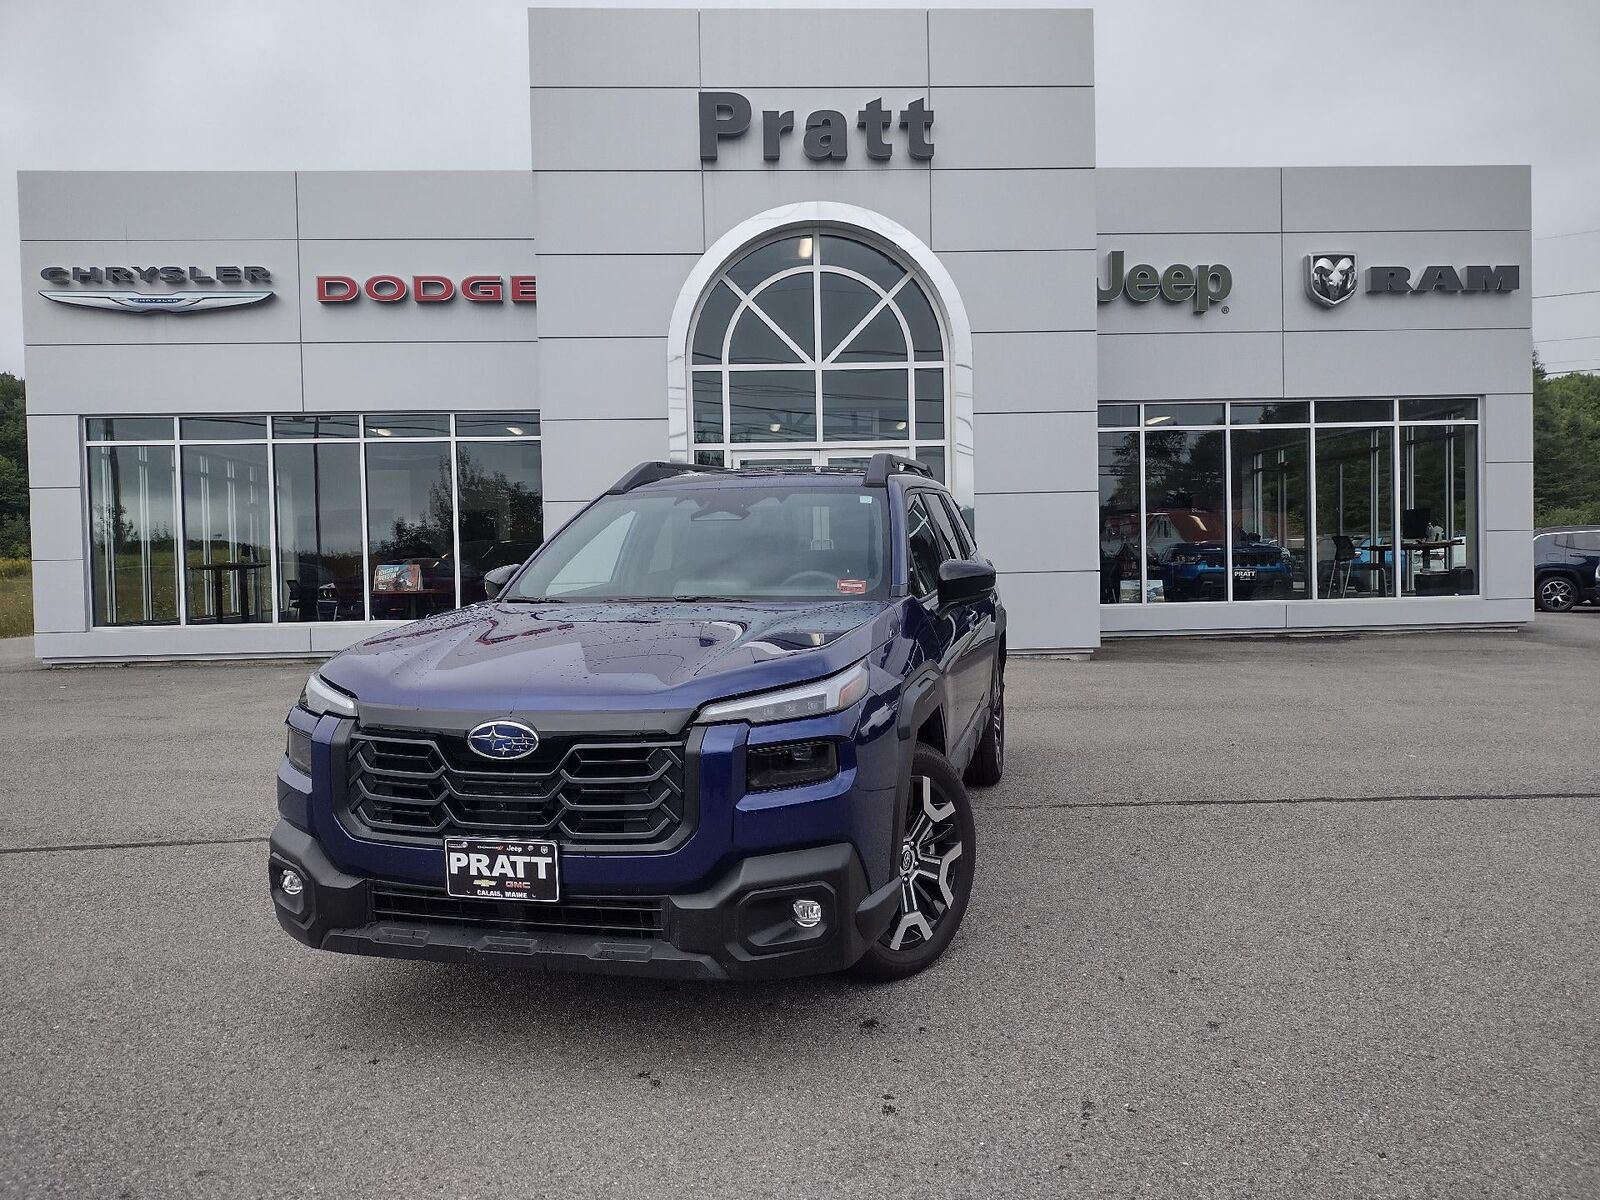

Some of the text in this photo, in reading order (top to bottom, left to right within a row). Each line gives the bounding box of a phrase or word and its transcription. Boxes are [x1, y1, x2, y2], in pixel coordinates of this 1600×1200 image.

[698, 92, 934, 160] Pratt
[41, 265, 273, 284] CHRYSLER
[1097, 250, 1232, 313] Jeep
[1366, 265, 1520, 294] RAM
[316, 275, 537, 303] DODGE
[449, 852, 552, 879] PRATT
[477, 889, 528, 898] CALAIS, MAINE
[505, 880, 531, 889] GMC
